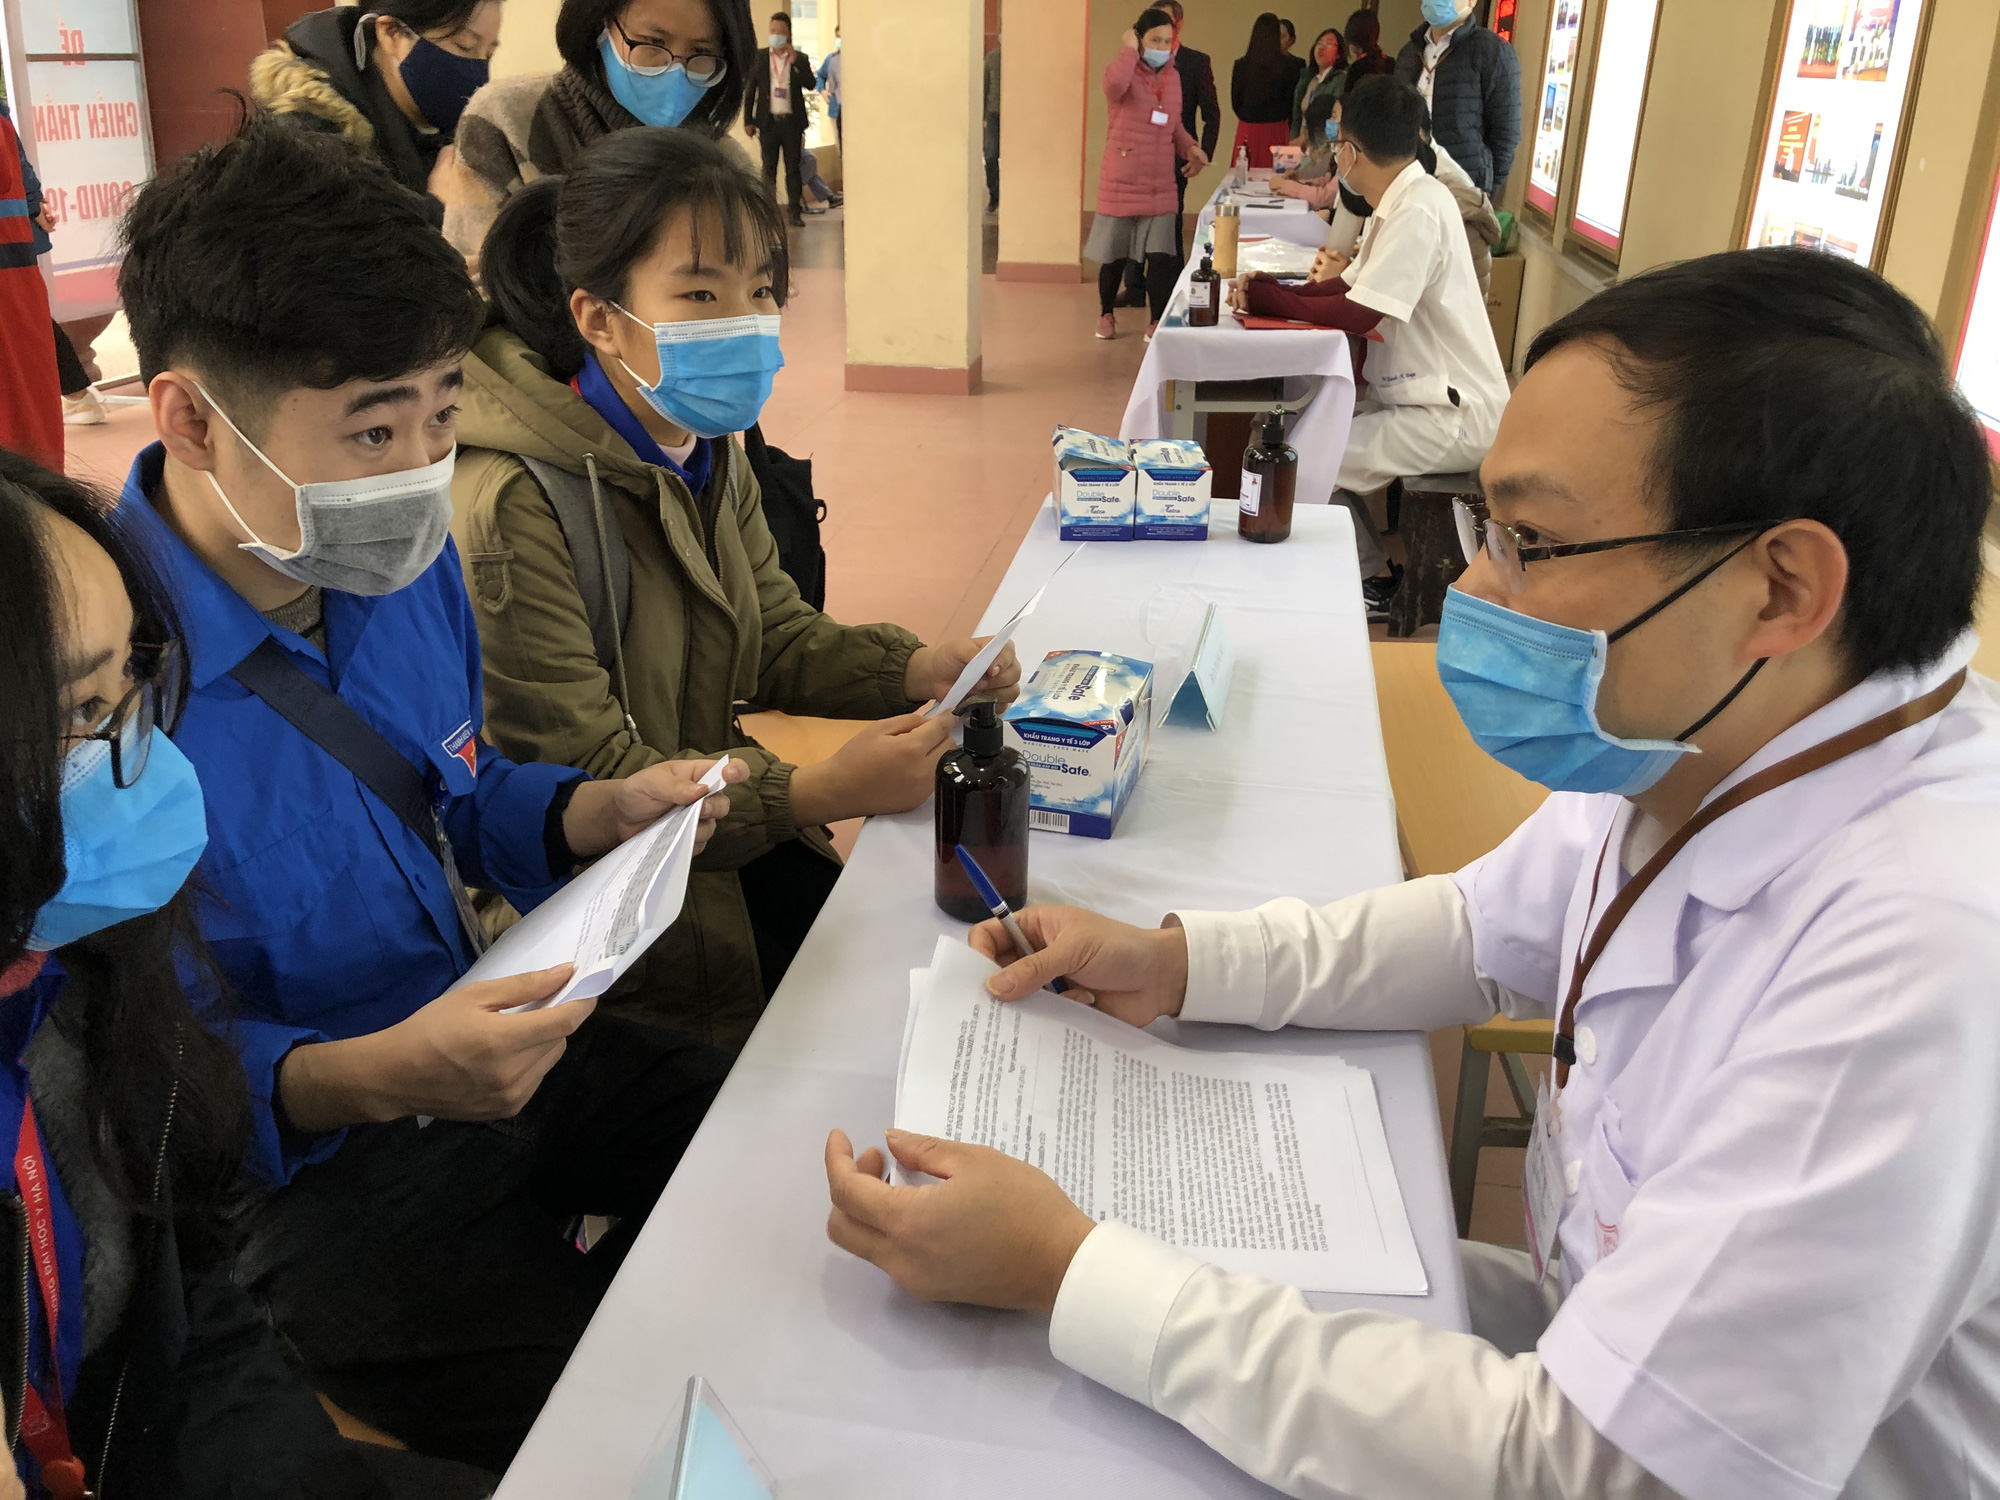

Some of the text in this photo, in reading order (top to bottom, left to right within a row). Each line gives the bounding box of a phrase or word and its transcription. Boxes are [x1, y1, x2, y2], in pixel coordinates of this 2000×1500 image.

[1068, 685, 1092, 701] Safe
[1022, 750, 1066, 765] Double
[1061, 763, 1089, 776] Safe
[22, 1155, 38, 1180] NỘI
[35, 1207, 44, 1216] Y
[36, 1218, 48, 1249] HỌC
